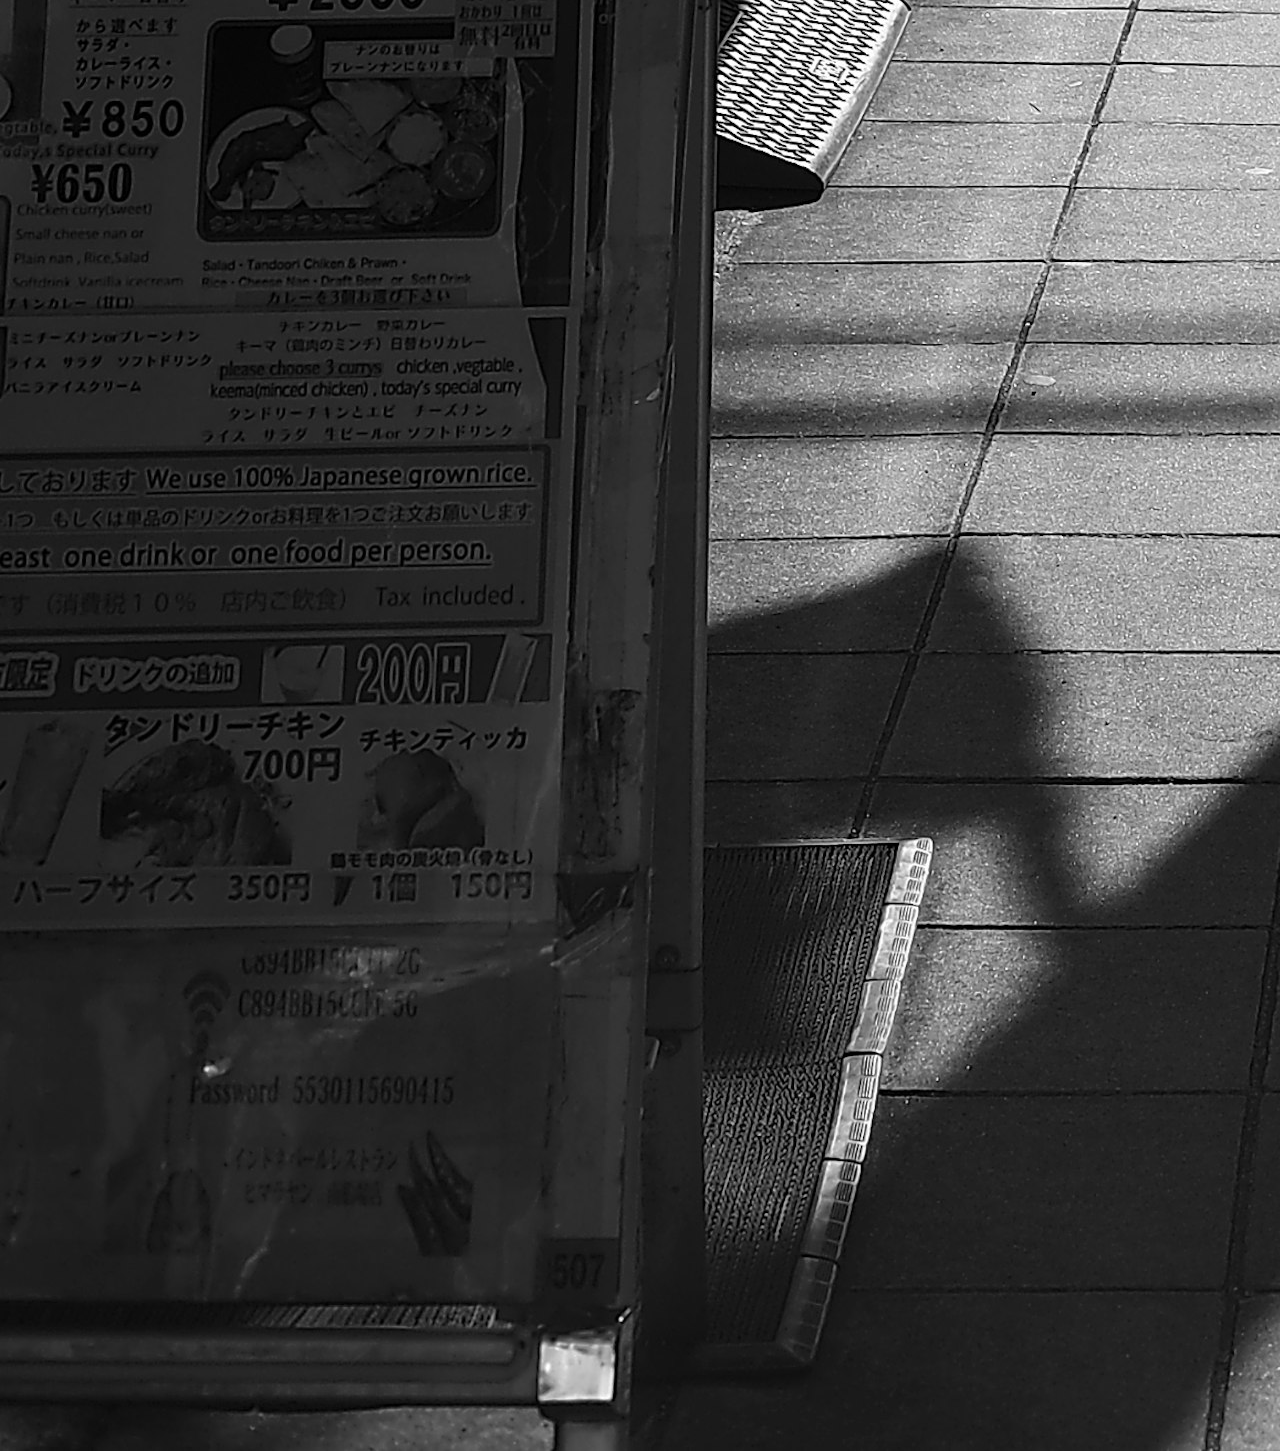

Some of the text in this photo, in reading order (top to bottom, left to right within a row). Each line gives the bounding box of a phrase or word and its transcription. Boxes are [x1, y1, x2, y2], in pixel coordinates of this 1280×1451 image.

[76, 16, 179, 34] から選べます
[77, 37, 130, 53] サラダ・
[75, 56, 173, 72] カレーライス・
[75, 75, 174, 91] ソフトドリンク
[61, 99, 186, 138] ¥850
[56, 144, 160, 159] Special Curry
[31, 162, 133, 204] ¥650
[17, 203, 68, 217] Chicken
[16, 227, 145, 241] Small cheese nan or
[13, 252, 74, 265] Plain nan
[202, 259, 236, 271] Salad
[248, 258, 300, 271] Tandoori
[360, 257, 398, 269] Prawn
[77, 276, 123, 289] Vanilla
[125, 277, 184, 288] icecream
[7, 353, 213, 369] ライス サラダ ソフトドリンク
[219, 361, 265, 380] please
[269, 360, 320, 375] choose
[337, 362, 382, 378] currys
[396, 358, 449, 375] chicken
[3, 378, 142, 394] バニラアイスクリーム
[210, 380, 522, 399] keema(minced today's special curry
[201, 429, 246, 443] ライス
[407, 424, 513, 439] ソフトドリンク
[146, 468, 182, 490] We
[189, 470, 227, 488] use
[234, 466, 294, 488] 100%
[300, 464, 402, 491] Japanese
[408, 466, 480, 488] grown
[486, 462, 533, 484] rice.
[64, 548, 112, 568] one
[119, 541, 184, 567] drink
[191, 547, 217, 565] or
[230, 546, 278, 565] one
[285, 537, 344, 564] food
[350, 544, 392, 568] per
[399, 541, 493, 568] person.
[375, 585, 410, 606] Tax
[79, 643, 471, 705] ドリンクの追加 200円
[105, 711, 345, 744] タンドリーチキン
[359, 727, 528, 752] チキンティッカ
[243, 748, 341, 782] 700円
[13, 871, 533, 904] ハーフサイズ 350円 1個 150円
[190, 1075, 280, 1104] Password
